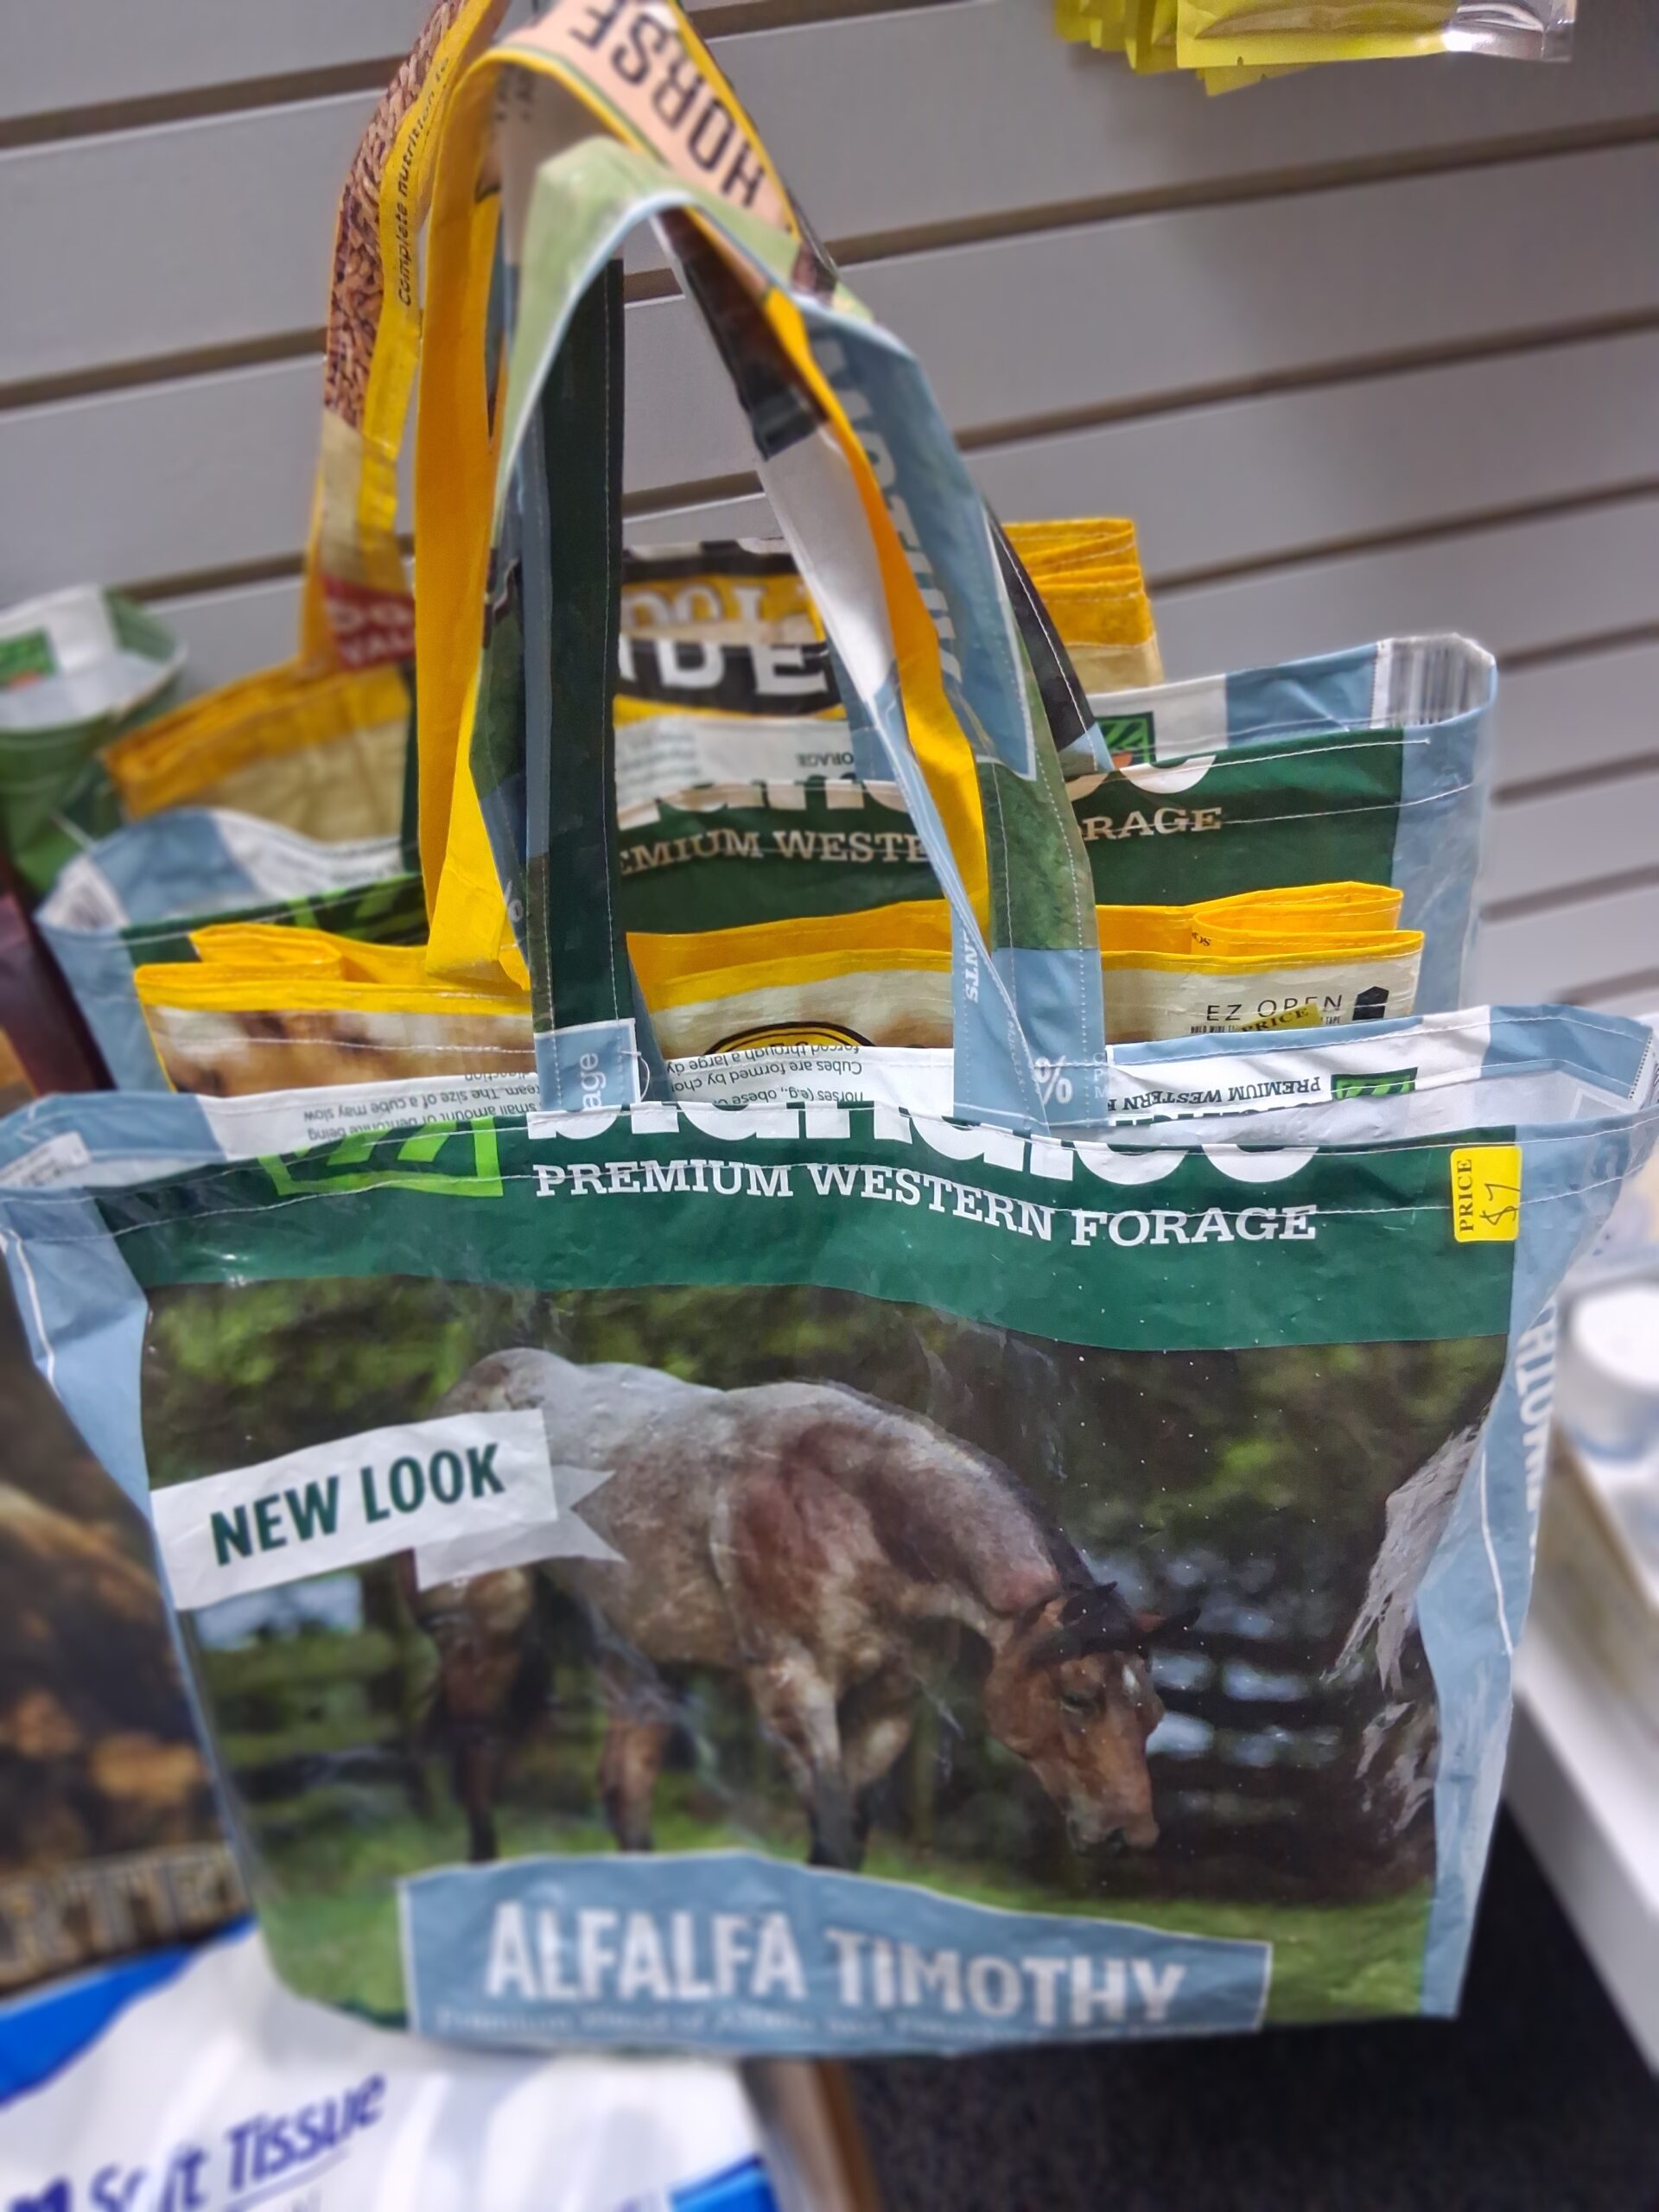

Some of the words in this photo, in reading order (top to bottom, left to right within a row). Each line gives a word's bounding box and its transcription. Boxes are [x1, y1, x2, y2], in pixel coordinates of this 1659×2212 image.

[397, 201, 410, 307] Complete
[1081, 807, 1222, 842] RAGE
[1206, 1004, 1243, 1021] EZ
[690, 1055, 729, 1071] large
[790, 1062, 812, 1071] are
[817, 1060, 862, 1075] Cubes
[706, 1071, 727, 1087] by
[730, 1063, 786, 1083] formed
[442, 1089, 468, 1104] size
[473, 1087, 500, 1100] The
[731, 1089, 778, 1105] obese
[779, 1086, 814, 1103] (e.g.,
[1227, 1076, 1322, 1103] PREMIUM
[371, 1097, 407, 1115] cube
[410, 1097, 418, 1108] a
[422, 1090, 438, 1107] of
[1123, 1090, 1223, 1111] WESTERN
[303, 1105, 335, 1122] slow
[337, 1103, 367, 1121] may
[439, 1105, 497, 1122] amount
[499, 1101, 537, 1116] small
[306, 1125, 346, 1141] being
[532, 1159, 794, 1198] PREMIUM
[805, 1162, 1056, 1242] WESTERN
[1071, 1204, 1319, 1247] FORAGE
[1456, 1159, 1474, 1232] PRICE
[1479, 1182, 1522, 1226] $7
[210, 1474, 340, 1567] NEW
[359, 1442, 506, 1525] LOOK
[484, 1900, 808, 2001] ALFALFA
[825, 1927, 1185, 2027] TIMOTHY
[226, 2070, 387, 2191] Tissue
